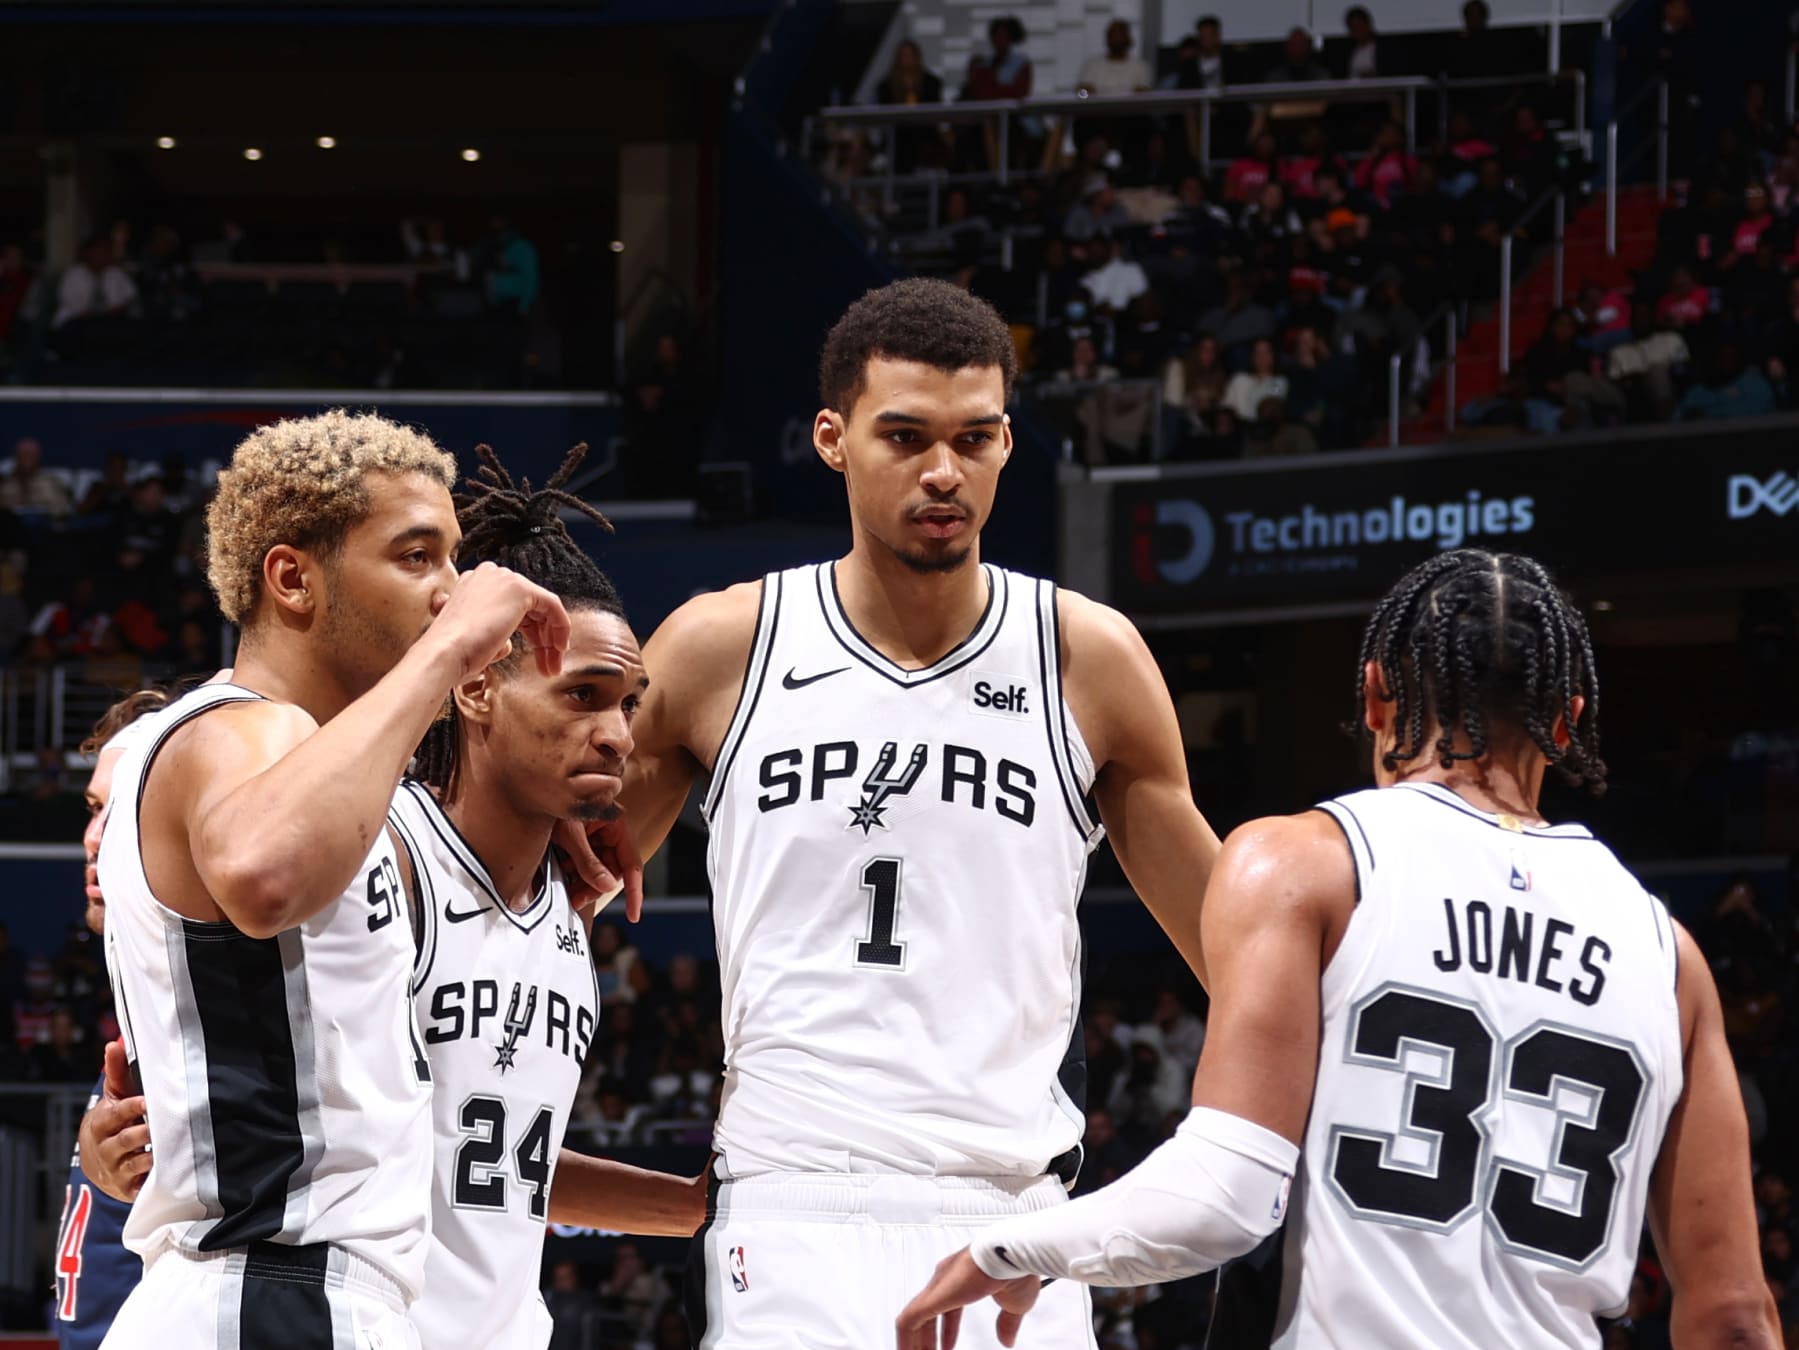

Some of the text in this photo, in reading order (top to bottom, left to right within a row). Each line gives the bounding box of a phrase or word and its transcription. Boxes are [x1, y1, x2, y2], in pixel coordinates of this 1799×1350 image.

[1225, 489, 1535, 549] Technologies
[1728, 469, 1799, 519] DE
[758, 740, 1037, 836] SPURS
[853, 856, 907, 971] 1
[1433, 898, 1612, 1007] JONES
[425, 979, 594, 1077] SPURS
[451, 1092, 555, 1224] 24
[1323, 980, 1654, 1275] 33
[55, 1183, 92, 1322] 4
